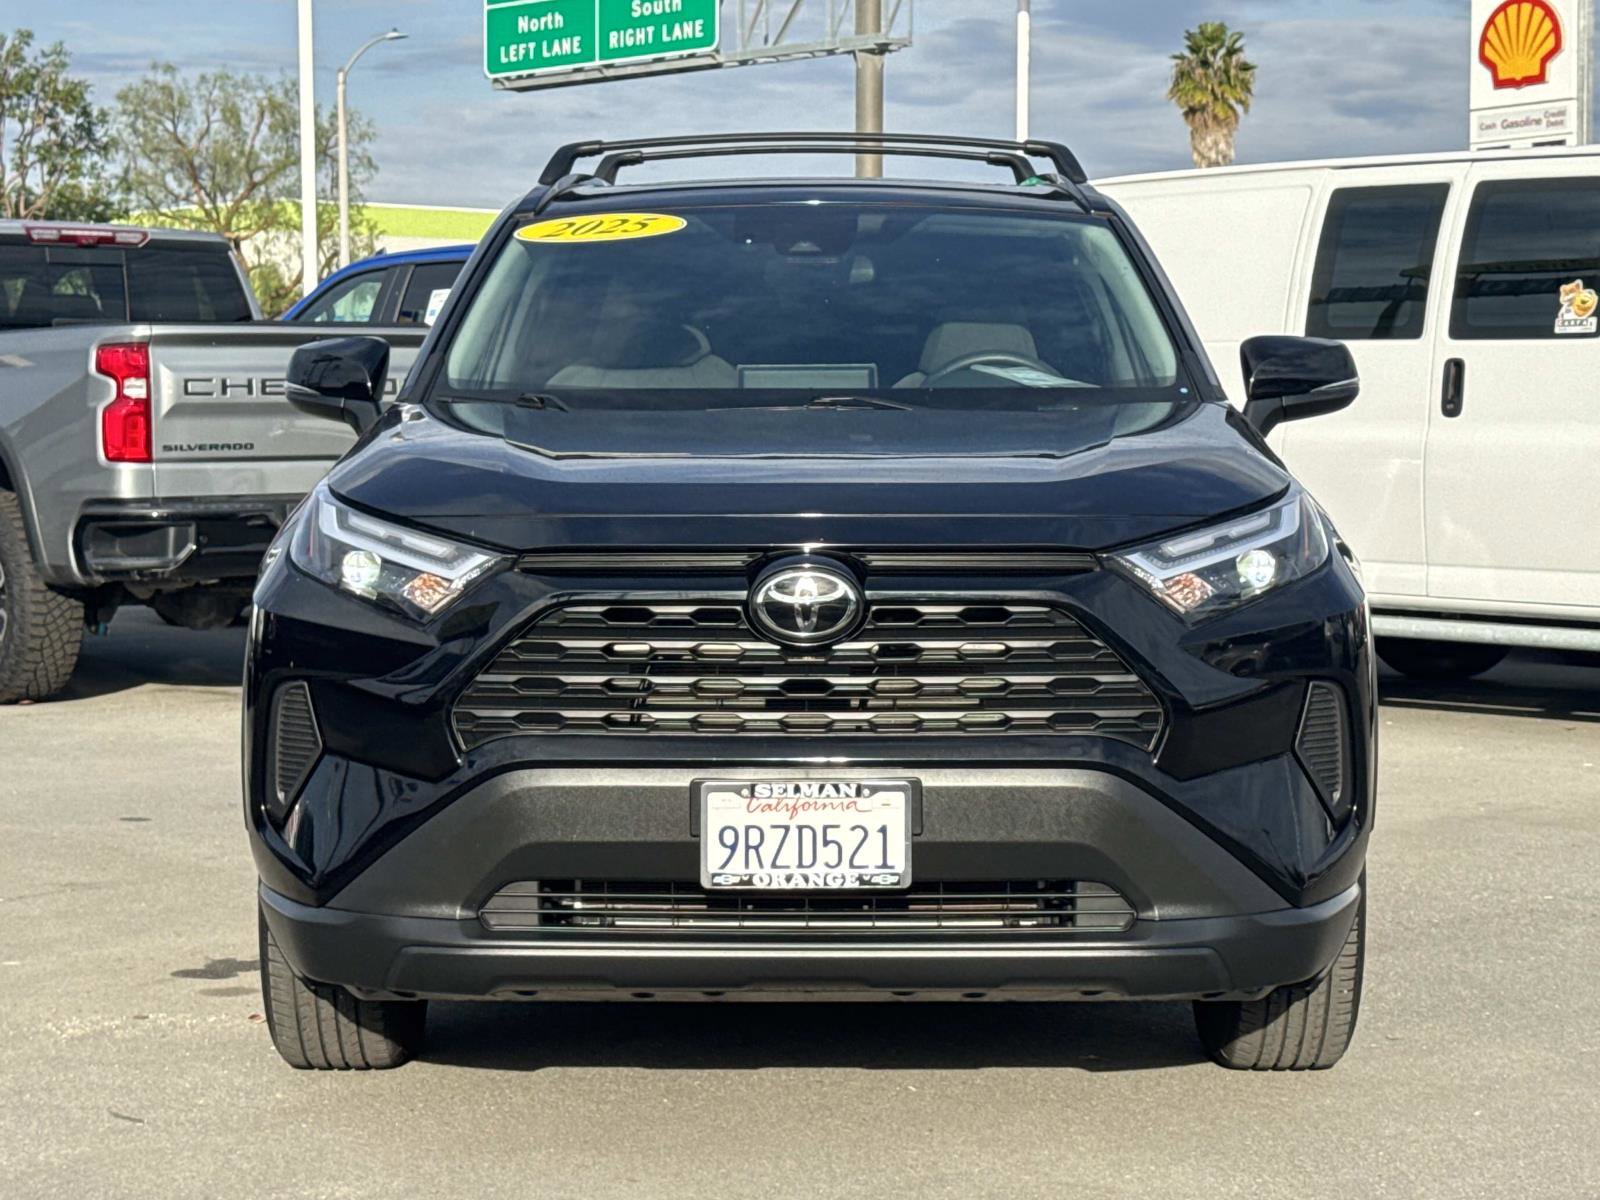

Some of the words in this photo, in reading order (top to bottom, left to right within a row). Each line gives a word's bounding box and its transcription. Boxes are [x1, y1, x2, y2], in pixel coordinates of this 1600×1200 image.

[631, 0, 682, 18] South
[517, 11, 564, 34] North
[609, 26, 655, 49] RIGHT
[661, 19, 705, 42] LANE
[500, 42, 536, 64] LEFT
[542, 36, 582, 58] LANE
[1501, 116, 1543, 130] Gasoline
[539, 217, 660, 238] 2025
[162, 442, 255, 452] SILVERADO
[754, 783, 858, 798] SELMAN
[747, 797, 872, 820] California
[718, 824, 896, 870] 9RZD521
[752, 872, 860, 887] ORANGE
